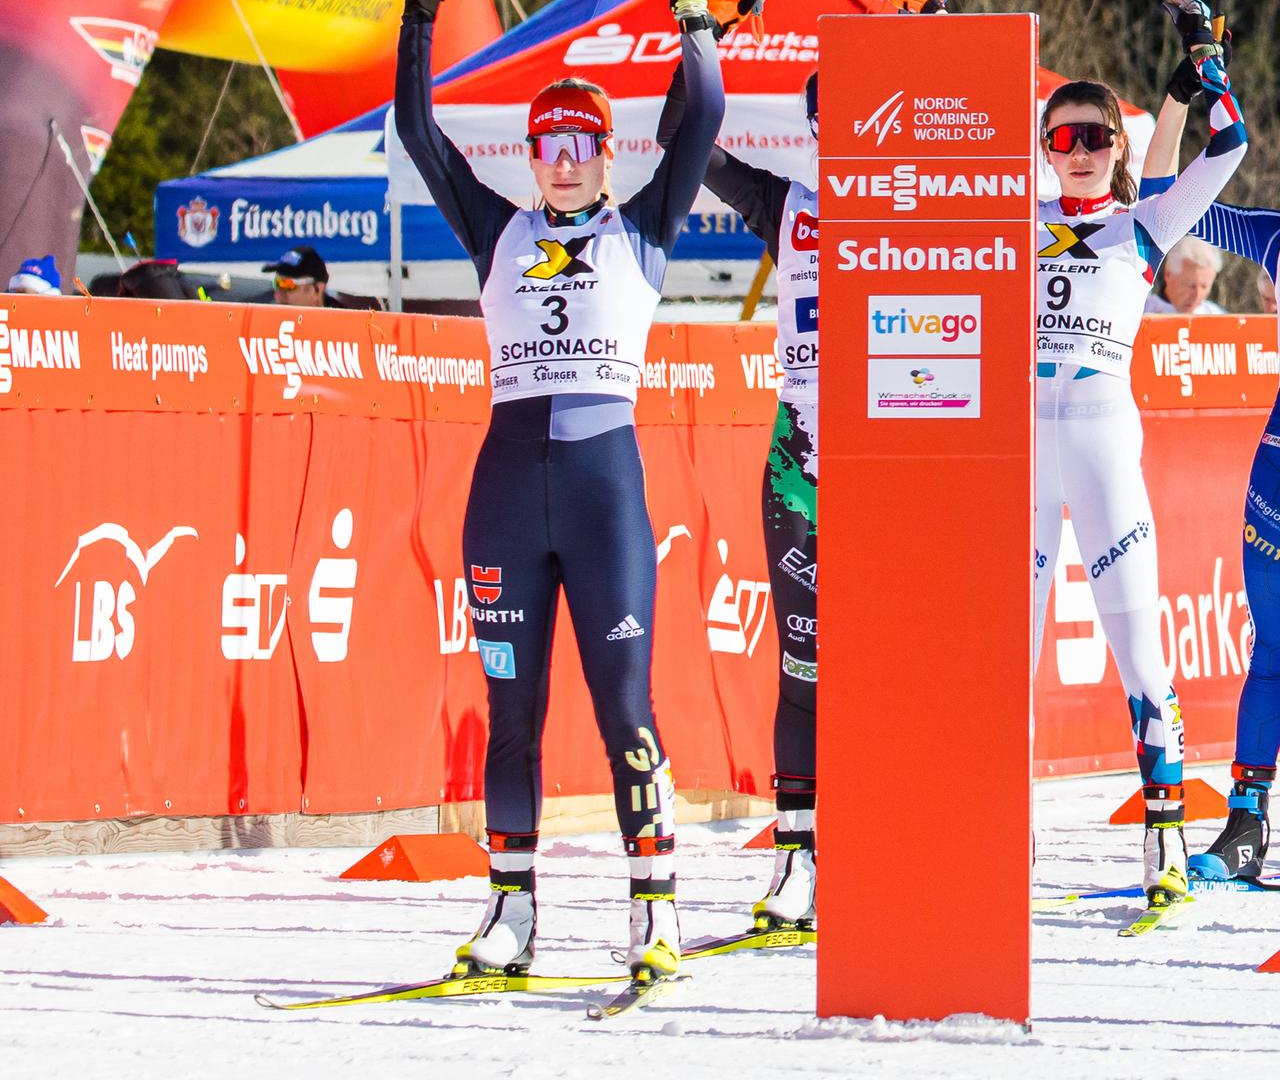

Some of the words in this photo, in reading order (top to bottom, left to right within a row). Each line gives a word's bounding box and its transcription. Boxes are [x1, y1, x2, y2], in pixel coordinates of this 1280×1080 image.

[914, 97, 968, 110] NORDIC
[533, 107, 602, 126] VIESSMANN
[914, 113, 989, 125] COMBINED
[914, 128, 964, 141] WORLD
[967, 128, 996, 141] CUP
[827, 165, 1026, 211] VIESSMANN
[230, 198, 378, 246] Fürstenberg
[837, 237, 1016, 271] Schonach
[1037, 263, 1101, 274] XELENT
[515, 280, 599, 294] AXELENT
[1047, 275, 1071, 311] 9
[540, 295, 569, 336] 3
[872, 308, 977, 342] trivago
[111, 332, 147, 372] Heat
[152, 338, 208, 382] pumps
[239, 320, 364, 399] VIESSMANN
[375, 342, 485, 395] Wärmepumpen
[501, 338, 618, 362] SCHONACH
[1152, 328, 1237, 396] VIESSMANN
[671, 361, 715, 397] pumps
[1091, 528, 1139, 580] CRAFT
[72, 580, 136, 662] LBS
[434, 579, 478, 655] LB
[471, 608, 524, 623] WÜRTH
[606, 626, 645, 641] adidas
[788, 632, 806, 643] Audi
[1193, 881, 1238, 892] SALOMON
[765, 933, 800, 945] FISCHER
[463, 978, 508, 992] FISCHER
